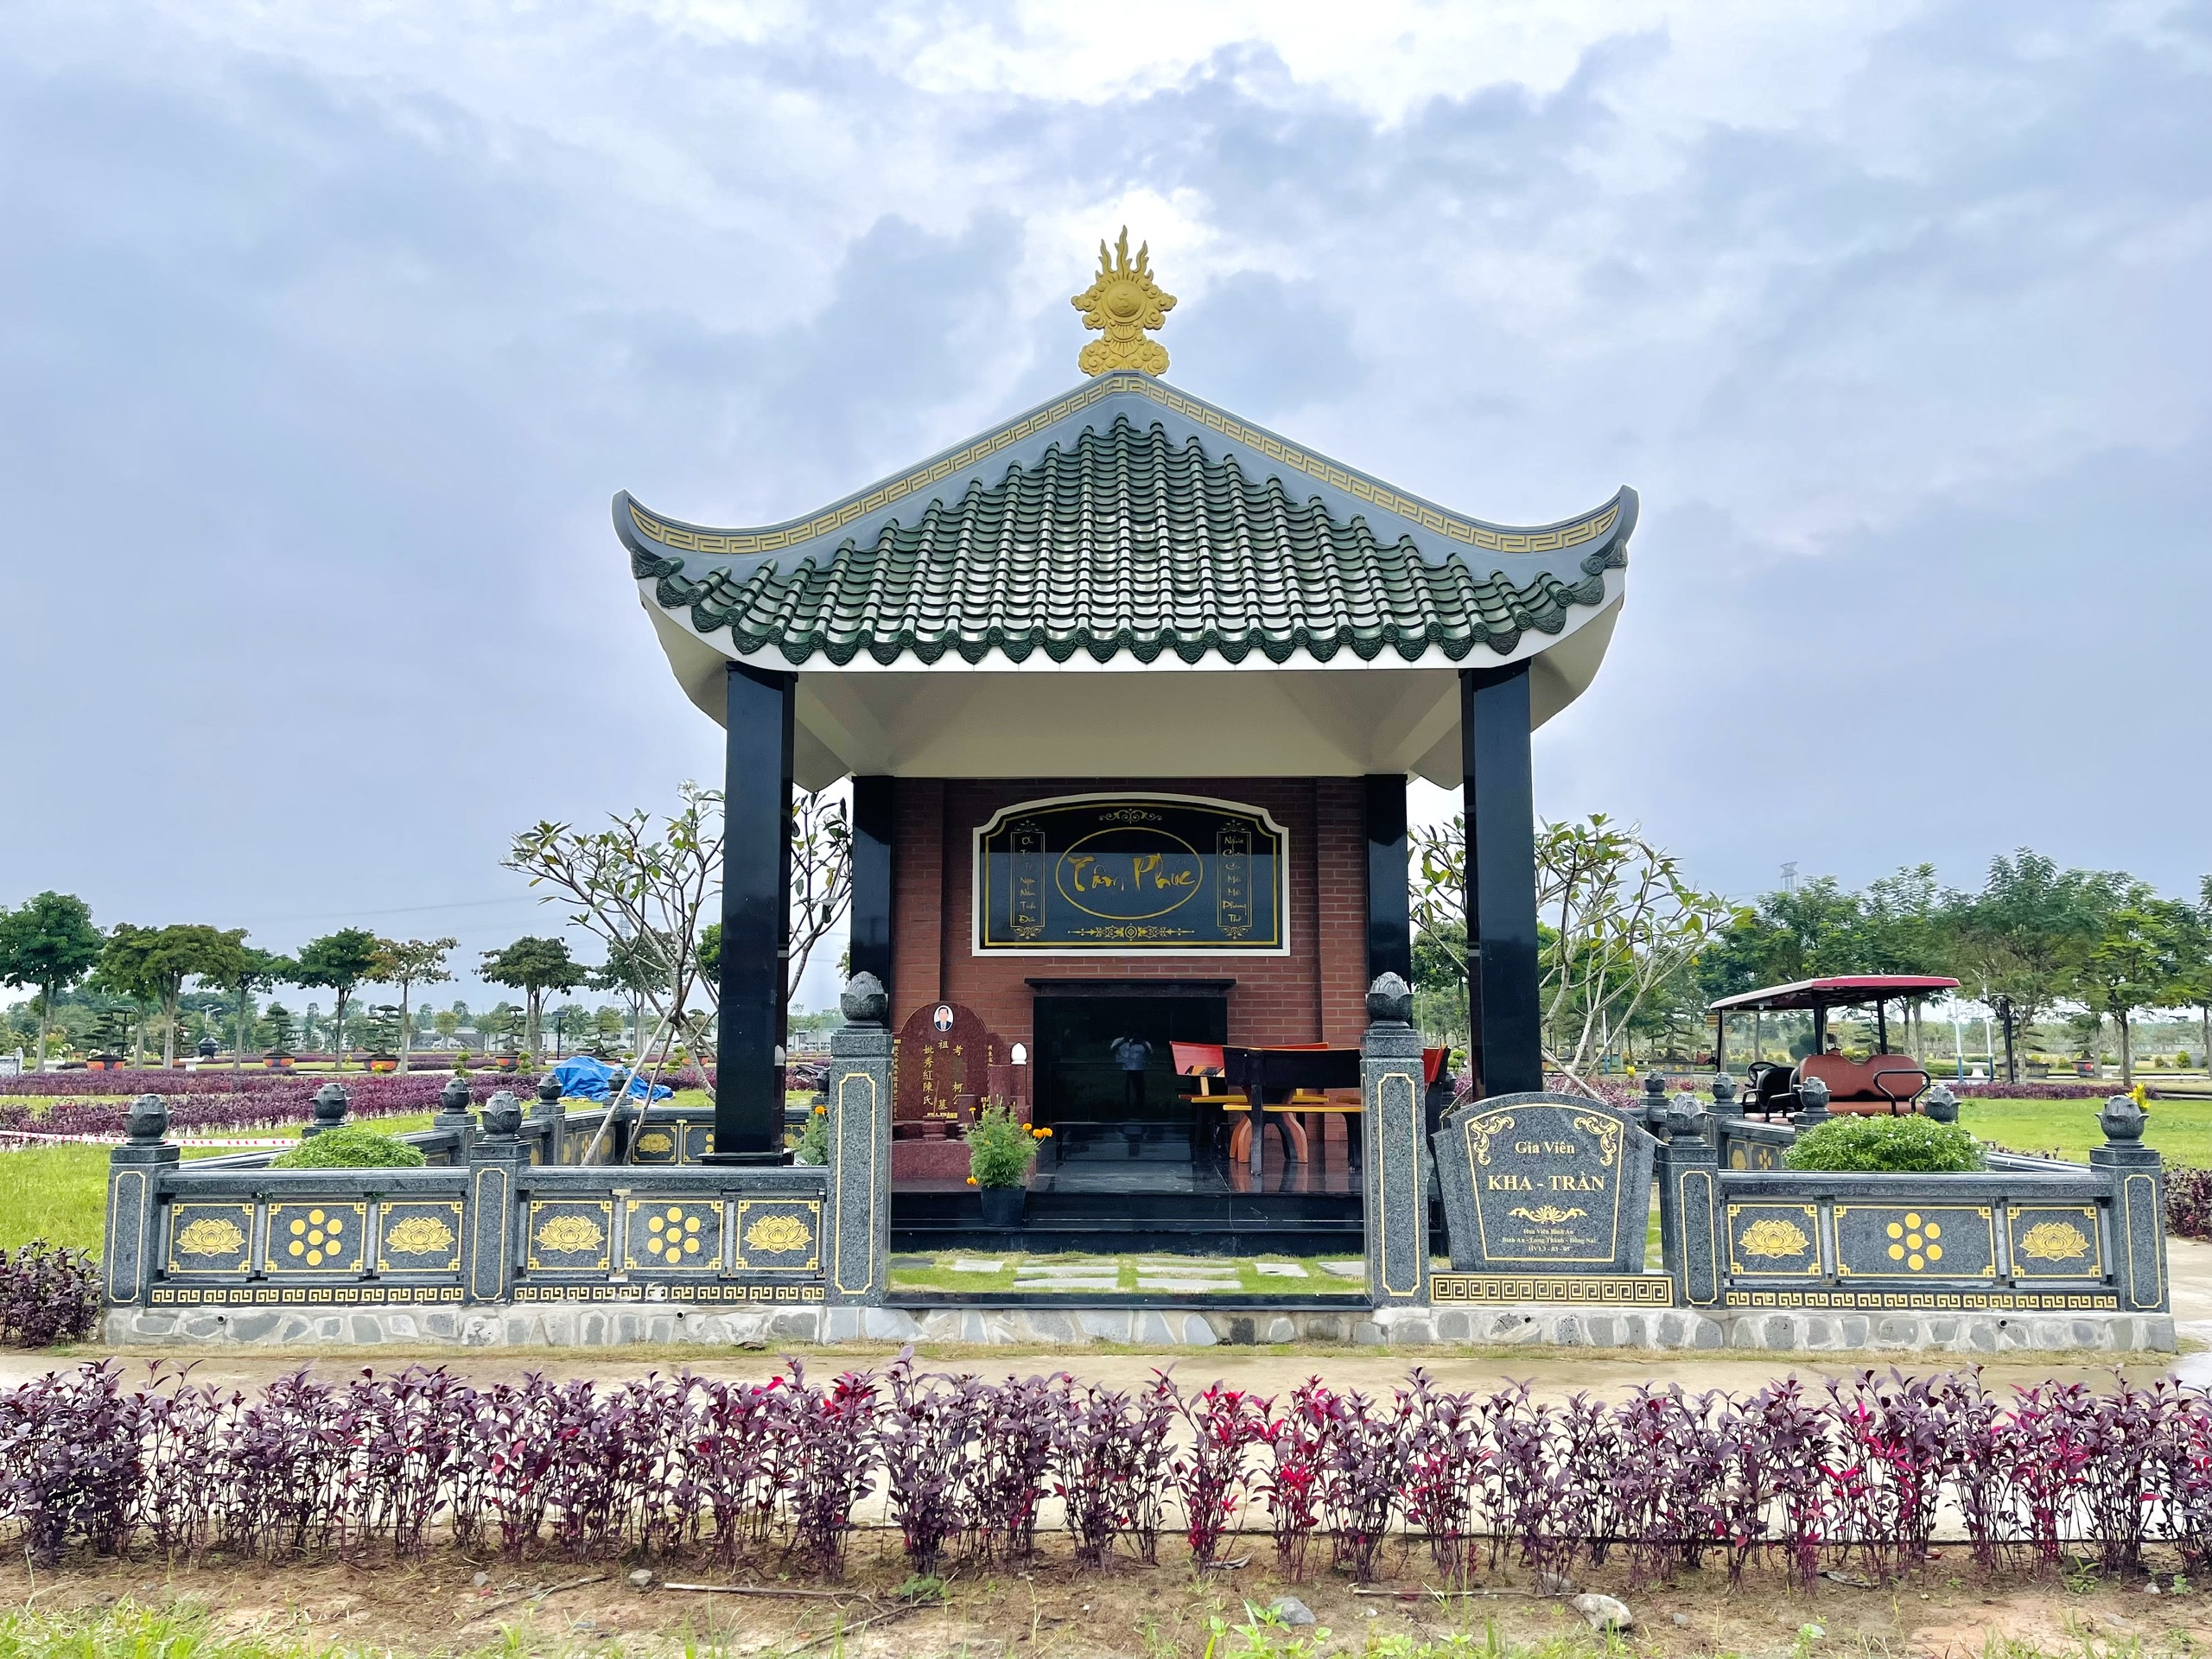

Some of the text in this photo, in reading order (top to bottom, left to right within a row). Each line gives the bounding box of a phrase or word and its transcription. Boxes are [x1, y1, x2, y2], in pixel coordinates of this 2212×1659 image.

[938, 1039, 950, 1050] 祖
[1515, 1141, 1575, 1154] Gia Viên
[1488, 1175, 1533, 1191] KHA
[1548, 1171, 1605, 1191] TRẦN
